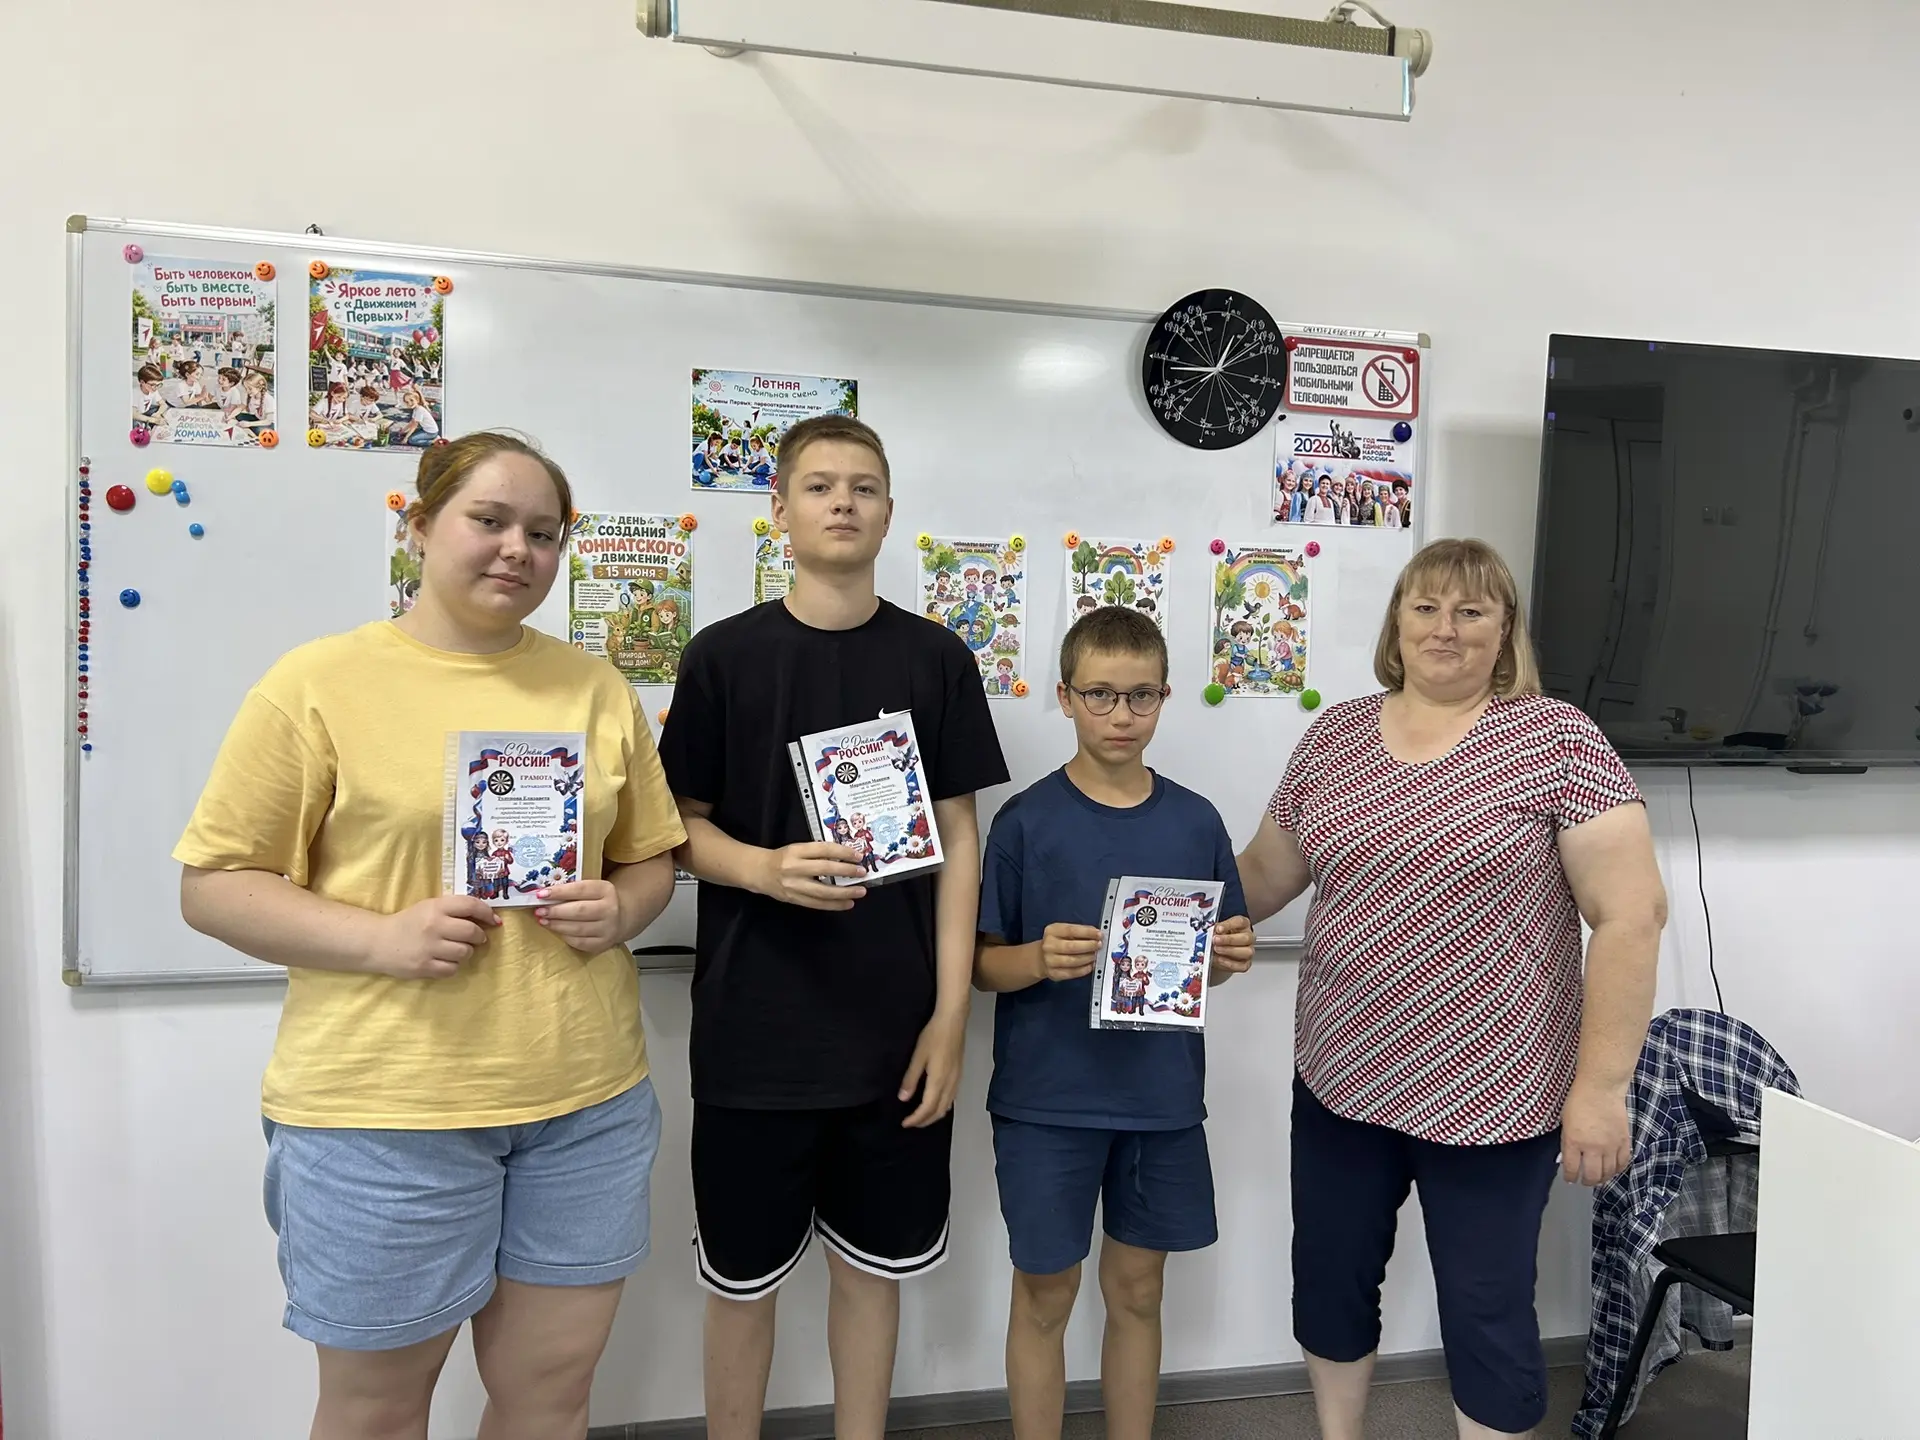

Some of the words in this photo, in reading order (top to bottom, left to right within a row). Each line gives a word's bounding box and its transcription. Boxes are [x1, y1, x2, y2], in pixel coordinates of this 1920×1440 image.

[154, 267, 185, 280] Быть
[188, 270, 257, 281] человеком,
[166, 281, 198, 293] быть
[202, 283, 254, 294] вместе,
[338, 283, 381, 299] Яркое
[385, 287, 416, 297] лето
[200, 295, 256, 310] первым!
[334, 301, 340, 309] с
[1294, 346, 1355, 361] ЗАПРЕЩАЕТСЯ
[1293, 361, 1358, 377] ПОЛЬЗОВАТЬСЯ
[752, 376, 800, 391] Летняя
[1293, 376, 1354, 391] МОБИЛЬНЫМИ
[733, 384, 789, 398] профильная
[792, 389, 818, 398] смена
[1293, 391, 1348, 406] ТЕЛЕФОНАМИ
[174, 429, 221, 439] КОМАНДА
[1294, 437, 1331, 453] 2026
[1363, 443, 1395, 451] ЕДИНСТВА
[617, 516, 647, 525] ДЕНЬ
[597, 525, 666, 538] СОЗДАНИЯ
[577, 538, 685, 557] ЮННАТСКОГО
[600, 553, 668, 565] ДВИЖЕНИЯ
[605, 565, 619, 577] 15
[503, 742, 516, 756] С
[839, 736, 850, 749] С
[838, 741, 884, 760] РОССИИ!
[499, 756, 550, 767] РОССИИ!
[861, 754, 891, 765] ГРАМОТА
[1154, 885, 1165, 896] С
[1148, 896, 1191, 907] РОССИИ!
